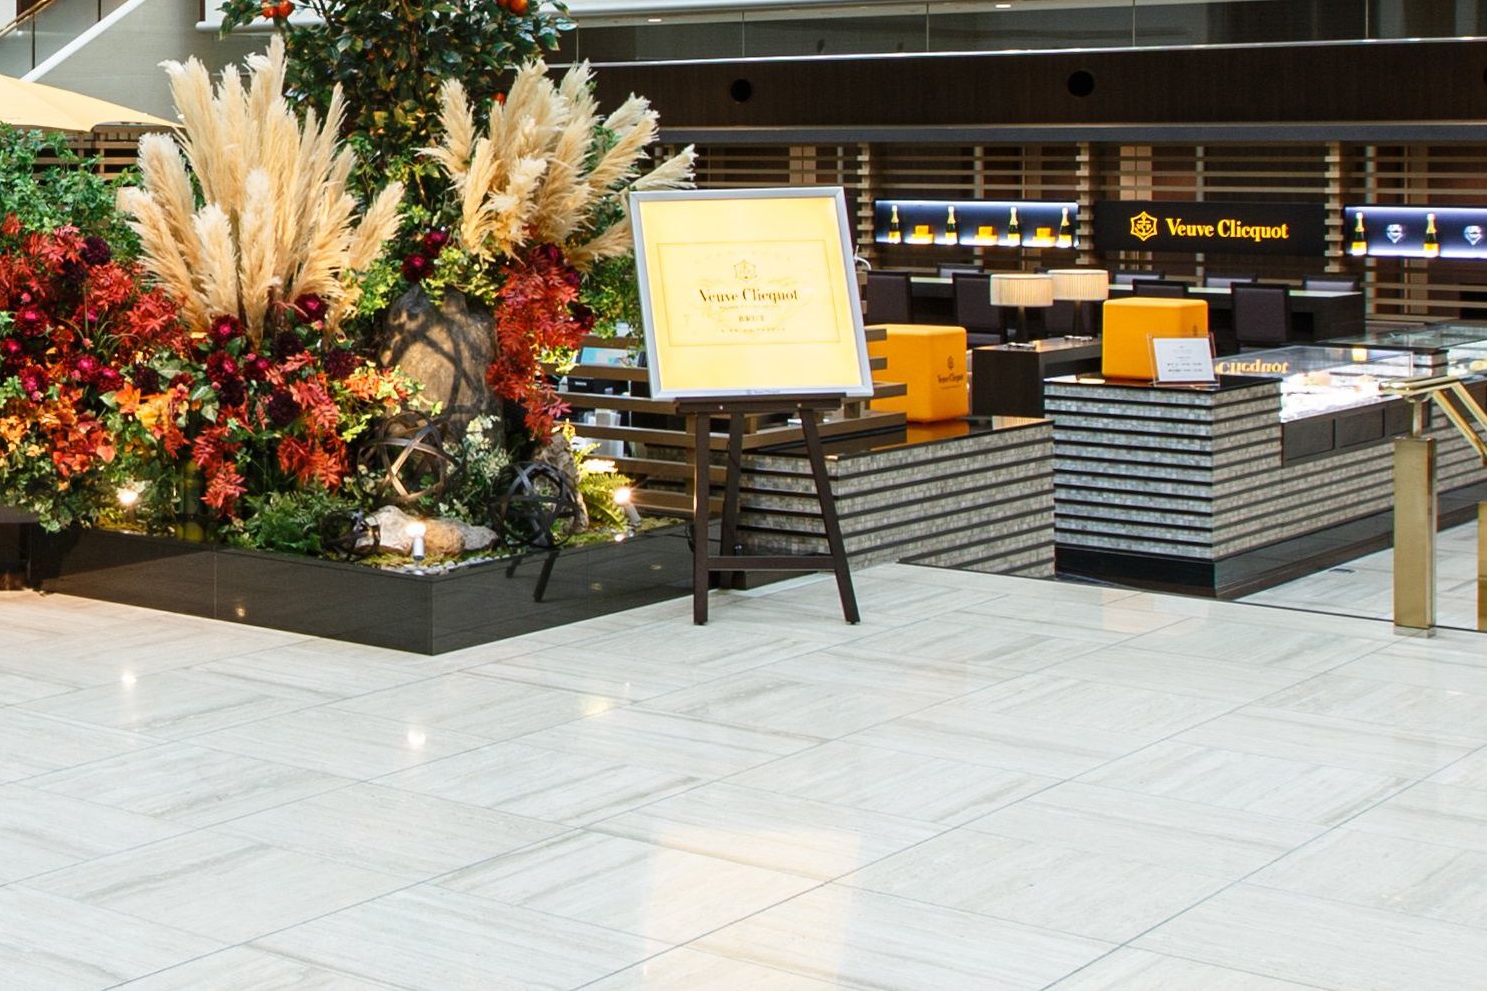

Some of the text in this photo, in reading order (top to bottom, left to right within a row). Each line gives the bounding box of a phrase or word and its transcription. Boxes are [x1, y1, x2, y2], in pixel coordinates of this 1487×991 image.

[1165, 217, 1289, 242] Veuve Clicquot
[699, 288, 798, 304] Veuve Clicquot
